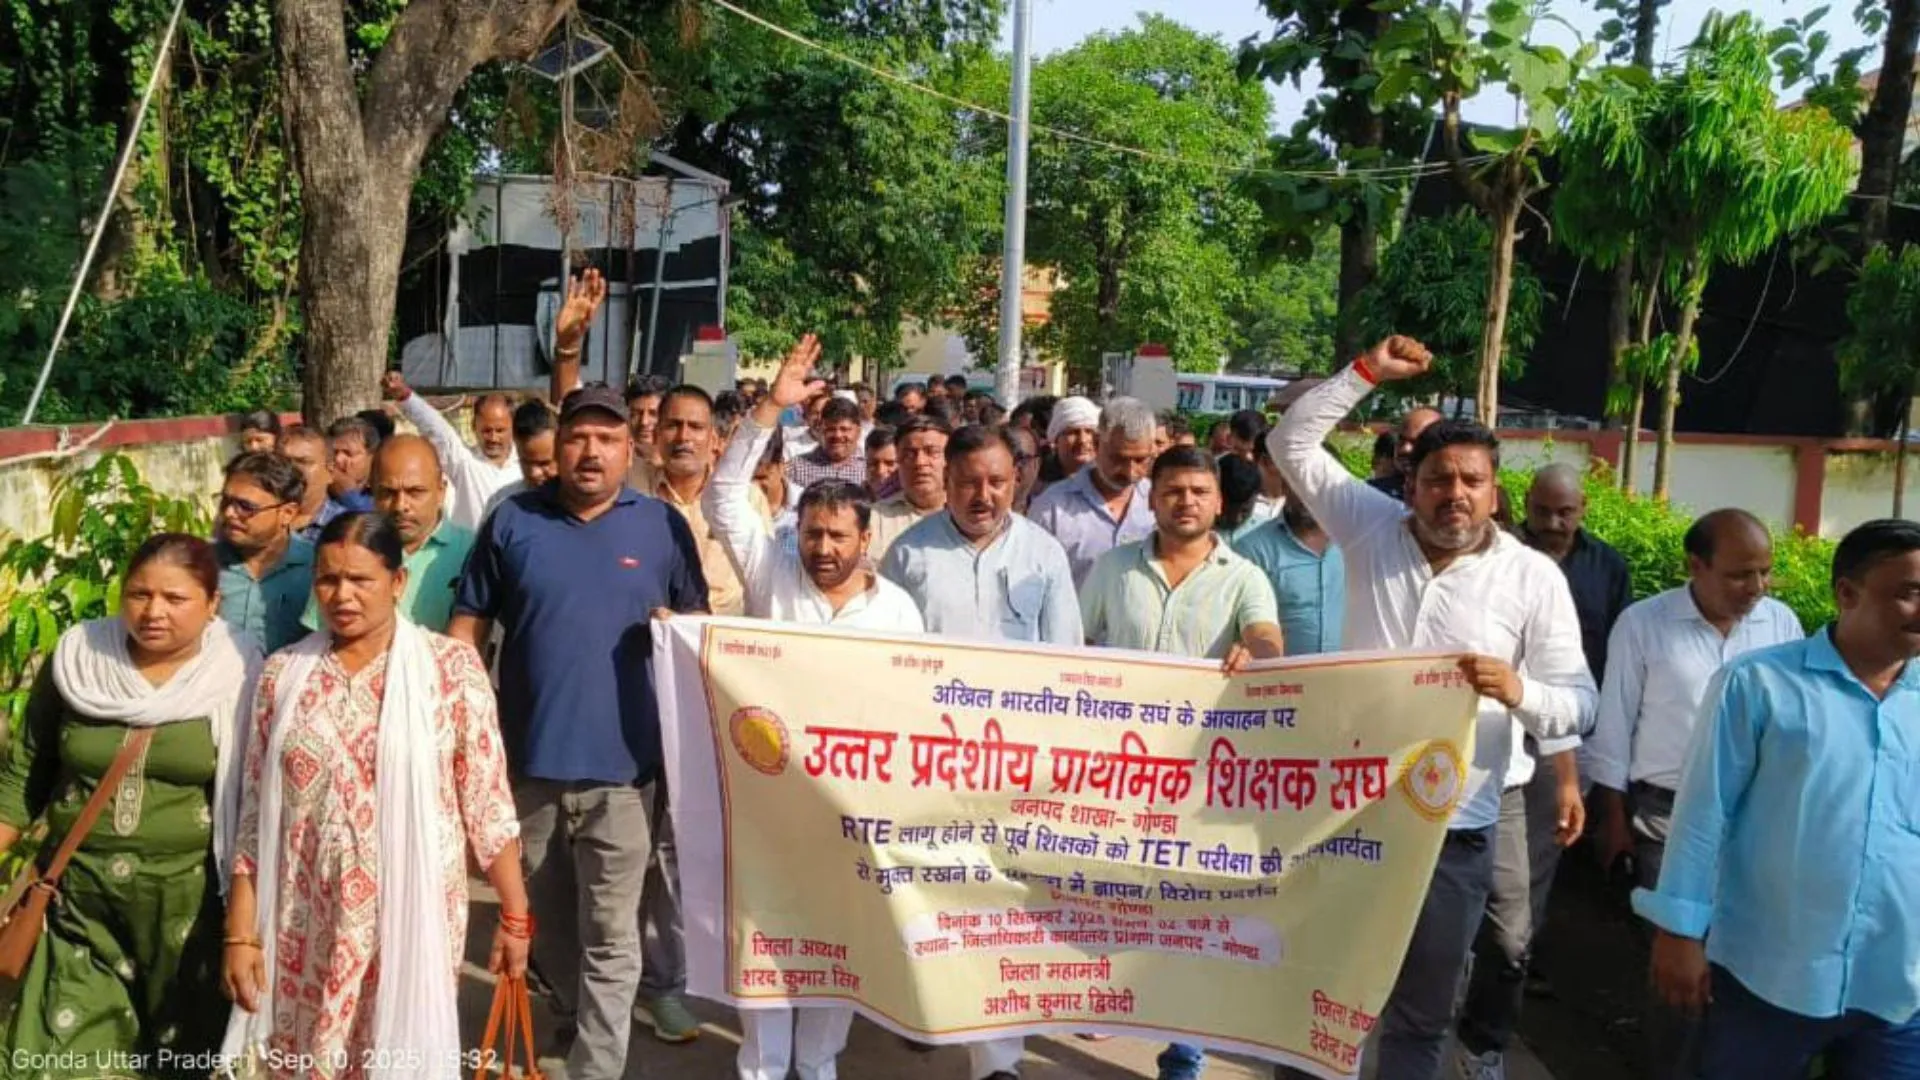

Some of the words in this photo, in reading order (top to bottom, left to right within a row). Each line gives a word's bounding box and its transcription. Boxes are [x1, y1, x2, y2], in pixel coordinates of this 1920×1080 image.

[933, 678, 993, 709] अखिल
[1000, 687, 1070, 716] भारतीय
[1076, 690, 1134, 721] शिक्षक
[1176, 700, 1195, 728] के
[1273, 707, 1297, 729] पर
[804, 726, 898, 783] उत्तर
[909, 713, 1038, 792] प्रदेशीय
[1049, 731, 1198, 803] प्राथमिक
[1206, 736, 1319, 811] शिक्षक
[1330, 740, 1389, 810] संघ
[1010, 799, 1065, 821] जनपद
[1133, 807, 1179, 837] गोण्डा
[840, 815, 892, 845] RTE
[898, 825, 936, 850] लागू
[941, 820, 975, 845] होने
[980, 819, 998, 845] से
[1003, 822, 1030, 855] पूर्व
[1035, 824, 1100, 858] शिक्षकों
[1106, 836, 1130, 862] को
[1139, 839, 1191, 868] TET
[1197, 843, 1253, 874] परीक्षा
[1259, 846, 1283, 874] की
[875, 866, 914, 894] मुक्त
[921, 857, 967, 883] रखने
[973, 859, 993, 883] के
[988, 913, 1002, 927] 10
[753, 931, 793, 957] जिला
[782, 969, 827, 993] कुमार
[1000, 957, 1041, 983] जिला
[1036, 992, 1083, 1018] कुमार
